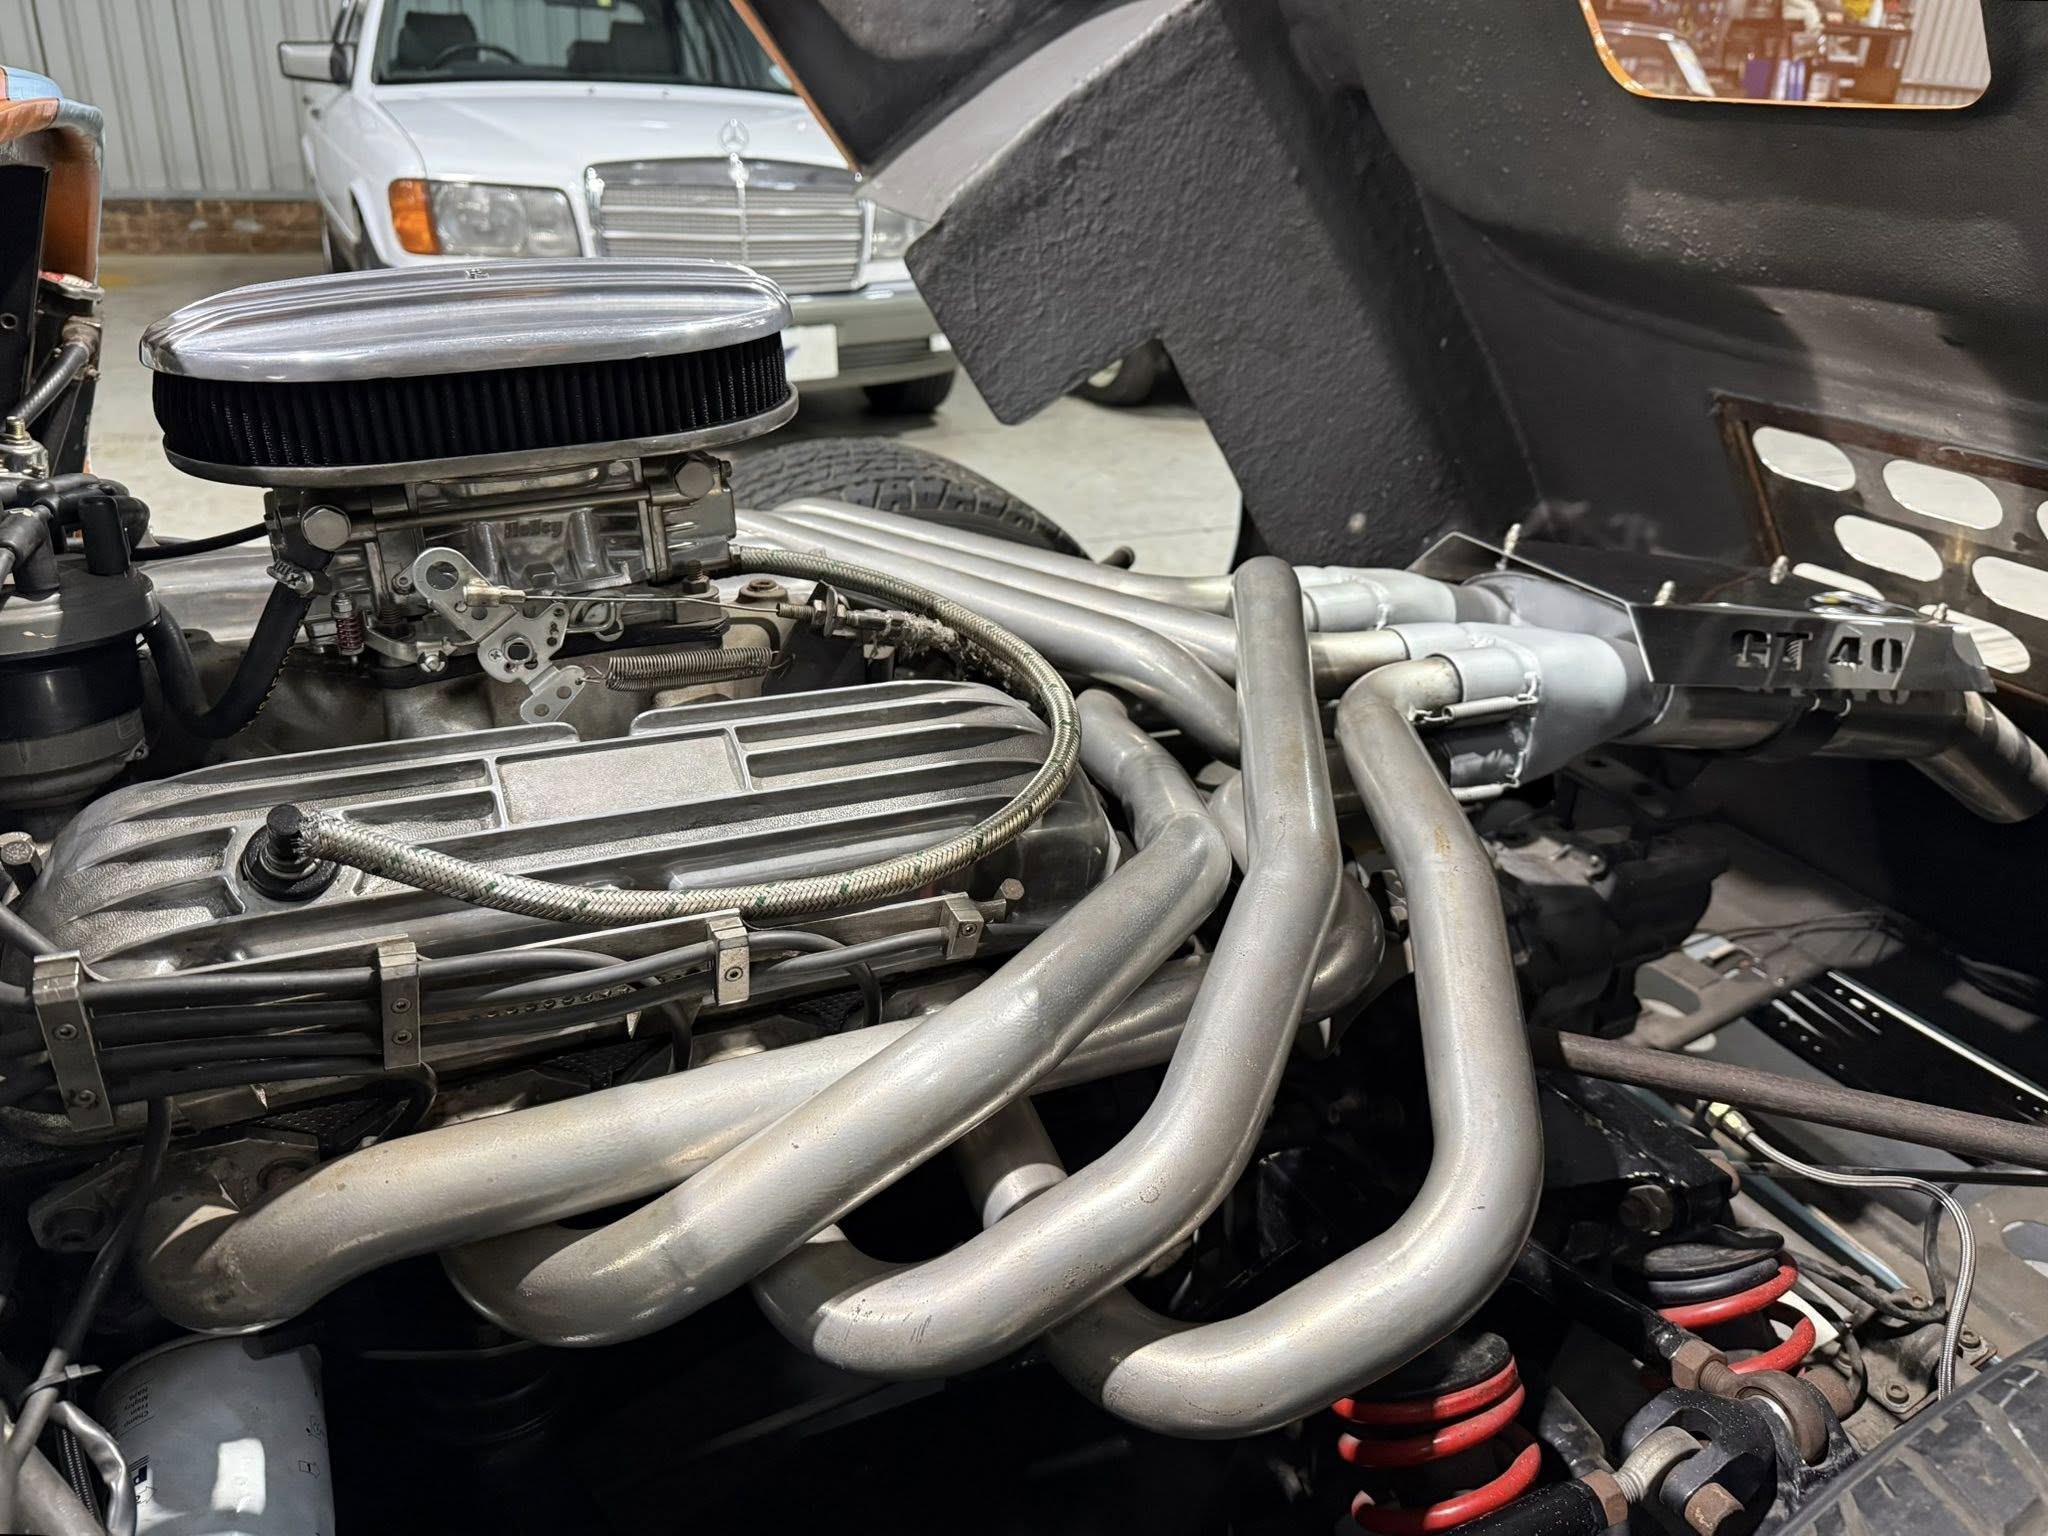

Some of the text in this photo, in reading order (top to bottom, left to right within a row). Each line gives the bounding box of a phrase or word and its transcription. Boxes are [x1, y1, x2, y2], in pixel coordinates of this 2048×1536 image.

[504, 519, 562, 538] Holley
[1730, 629, 1904, 673] GT 40
